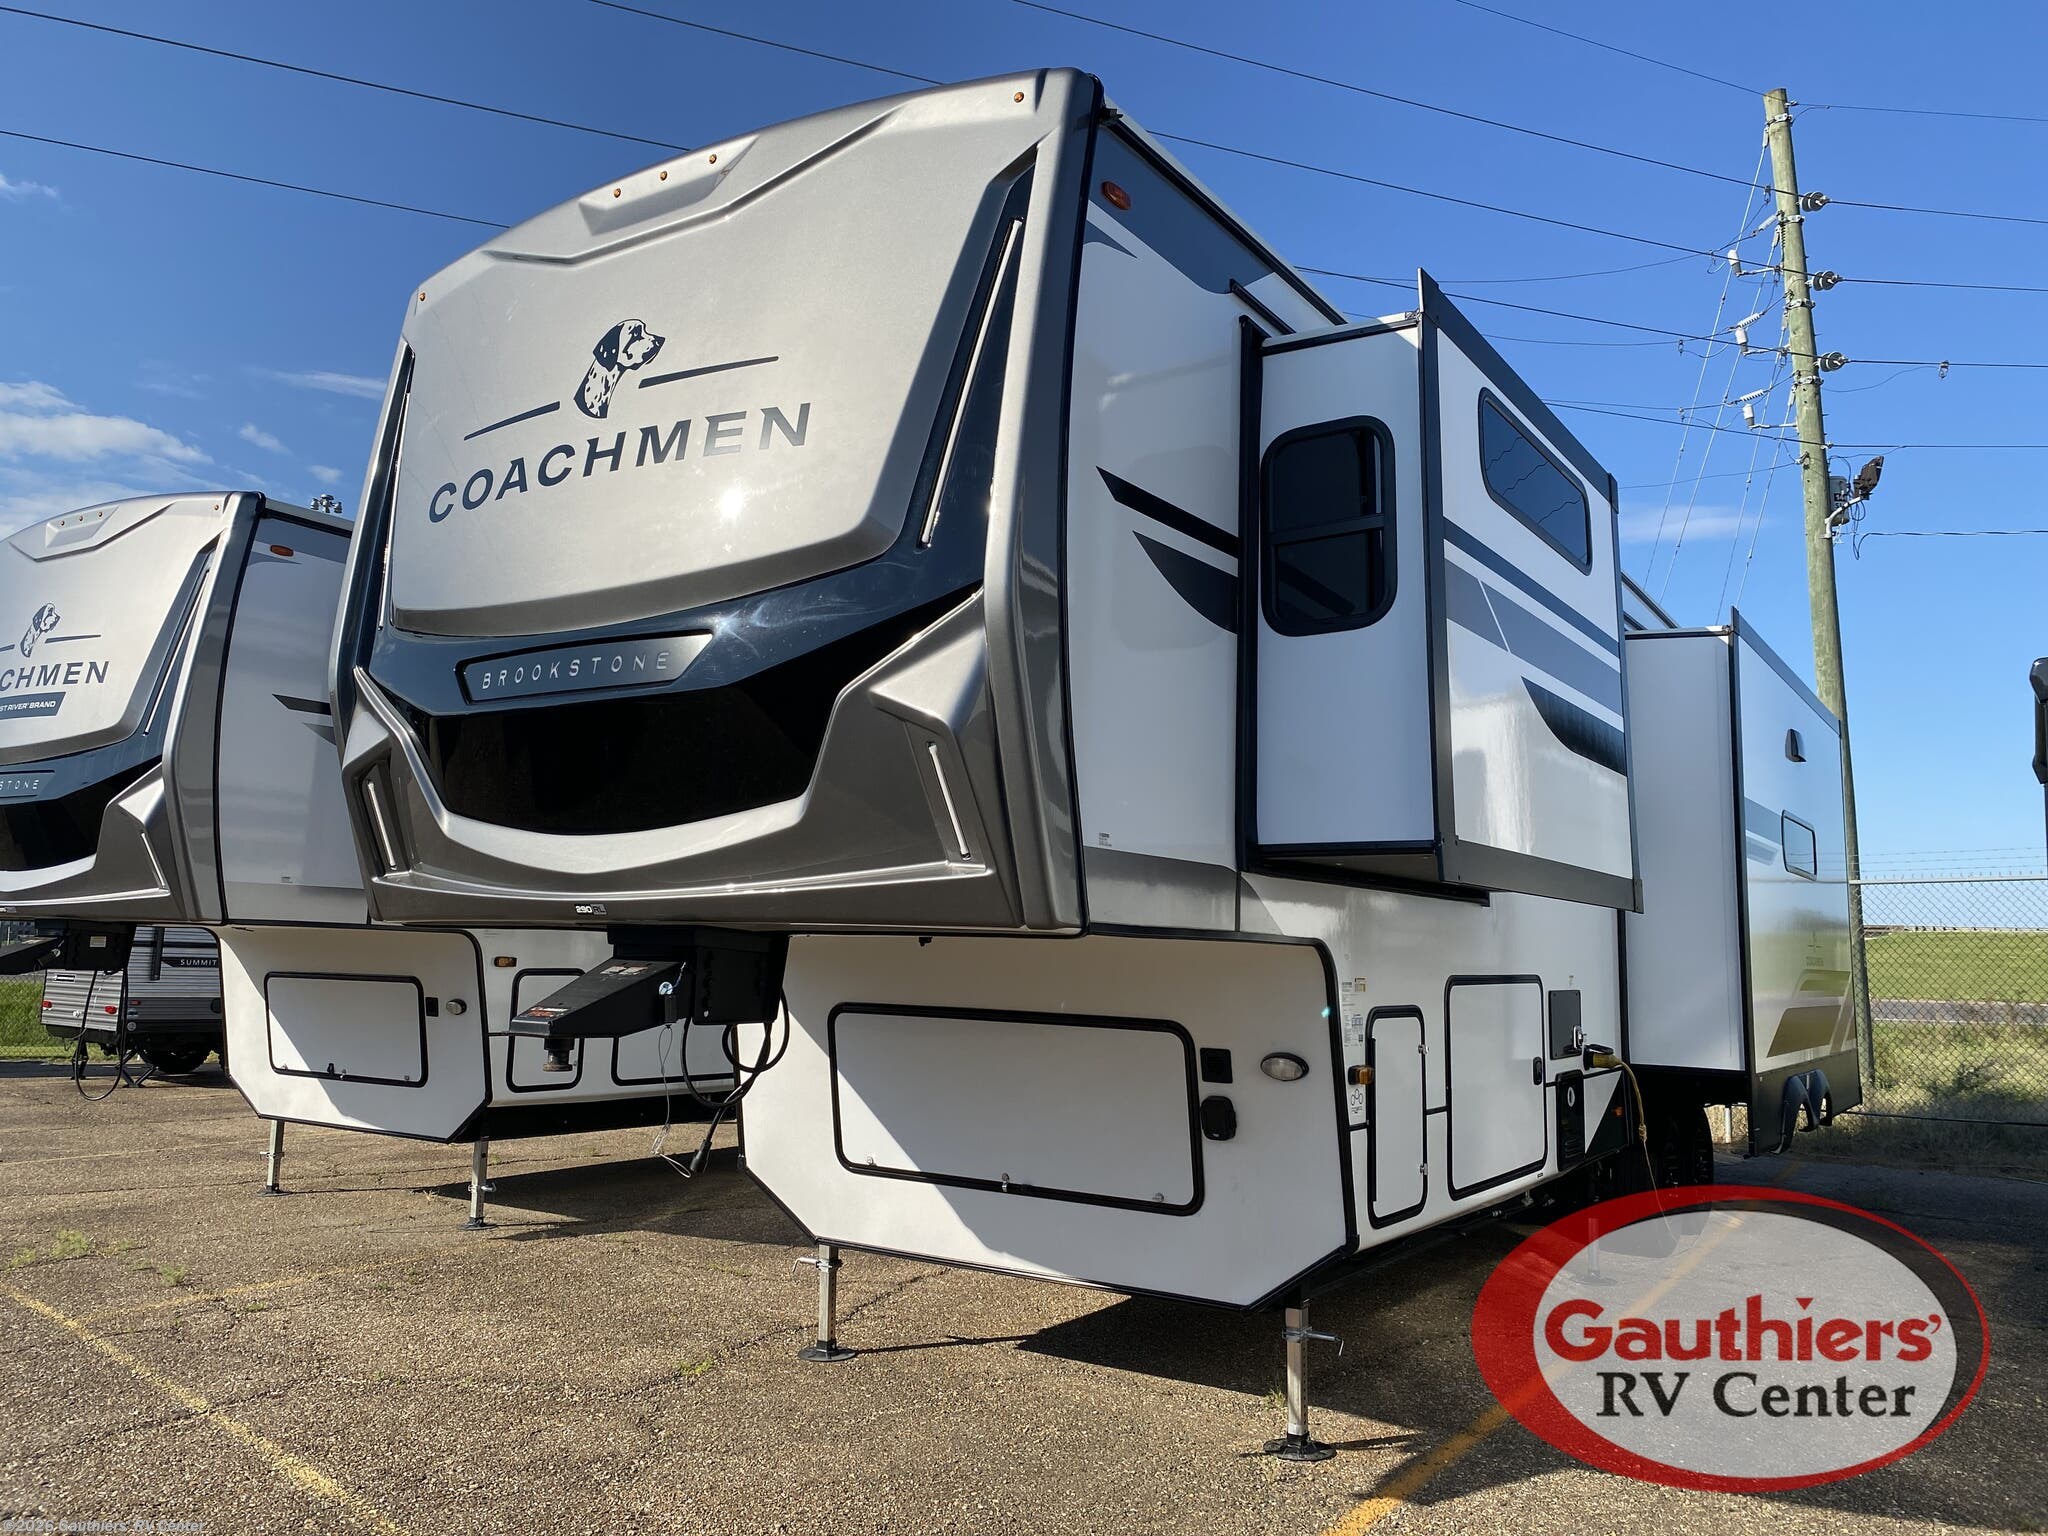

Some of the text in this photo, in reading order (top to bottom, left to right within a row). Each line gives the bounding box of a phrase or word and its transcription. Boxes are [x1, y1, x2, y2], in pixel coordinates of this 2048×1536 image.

[428, 403, 812, 523] COACHMEN
[481, 652, 671, 690] BROOKSTONE
[29, 700, 56, 709] BRAND
